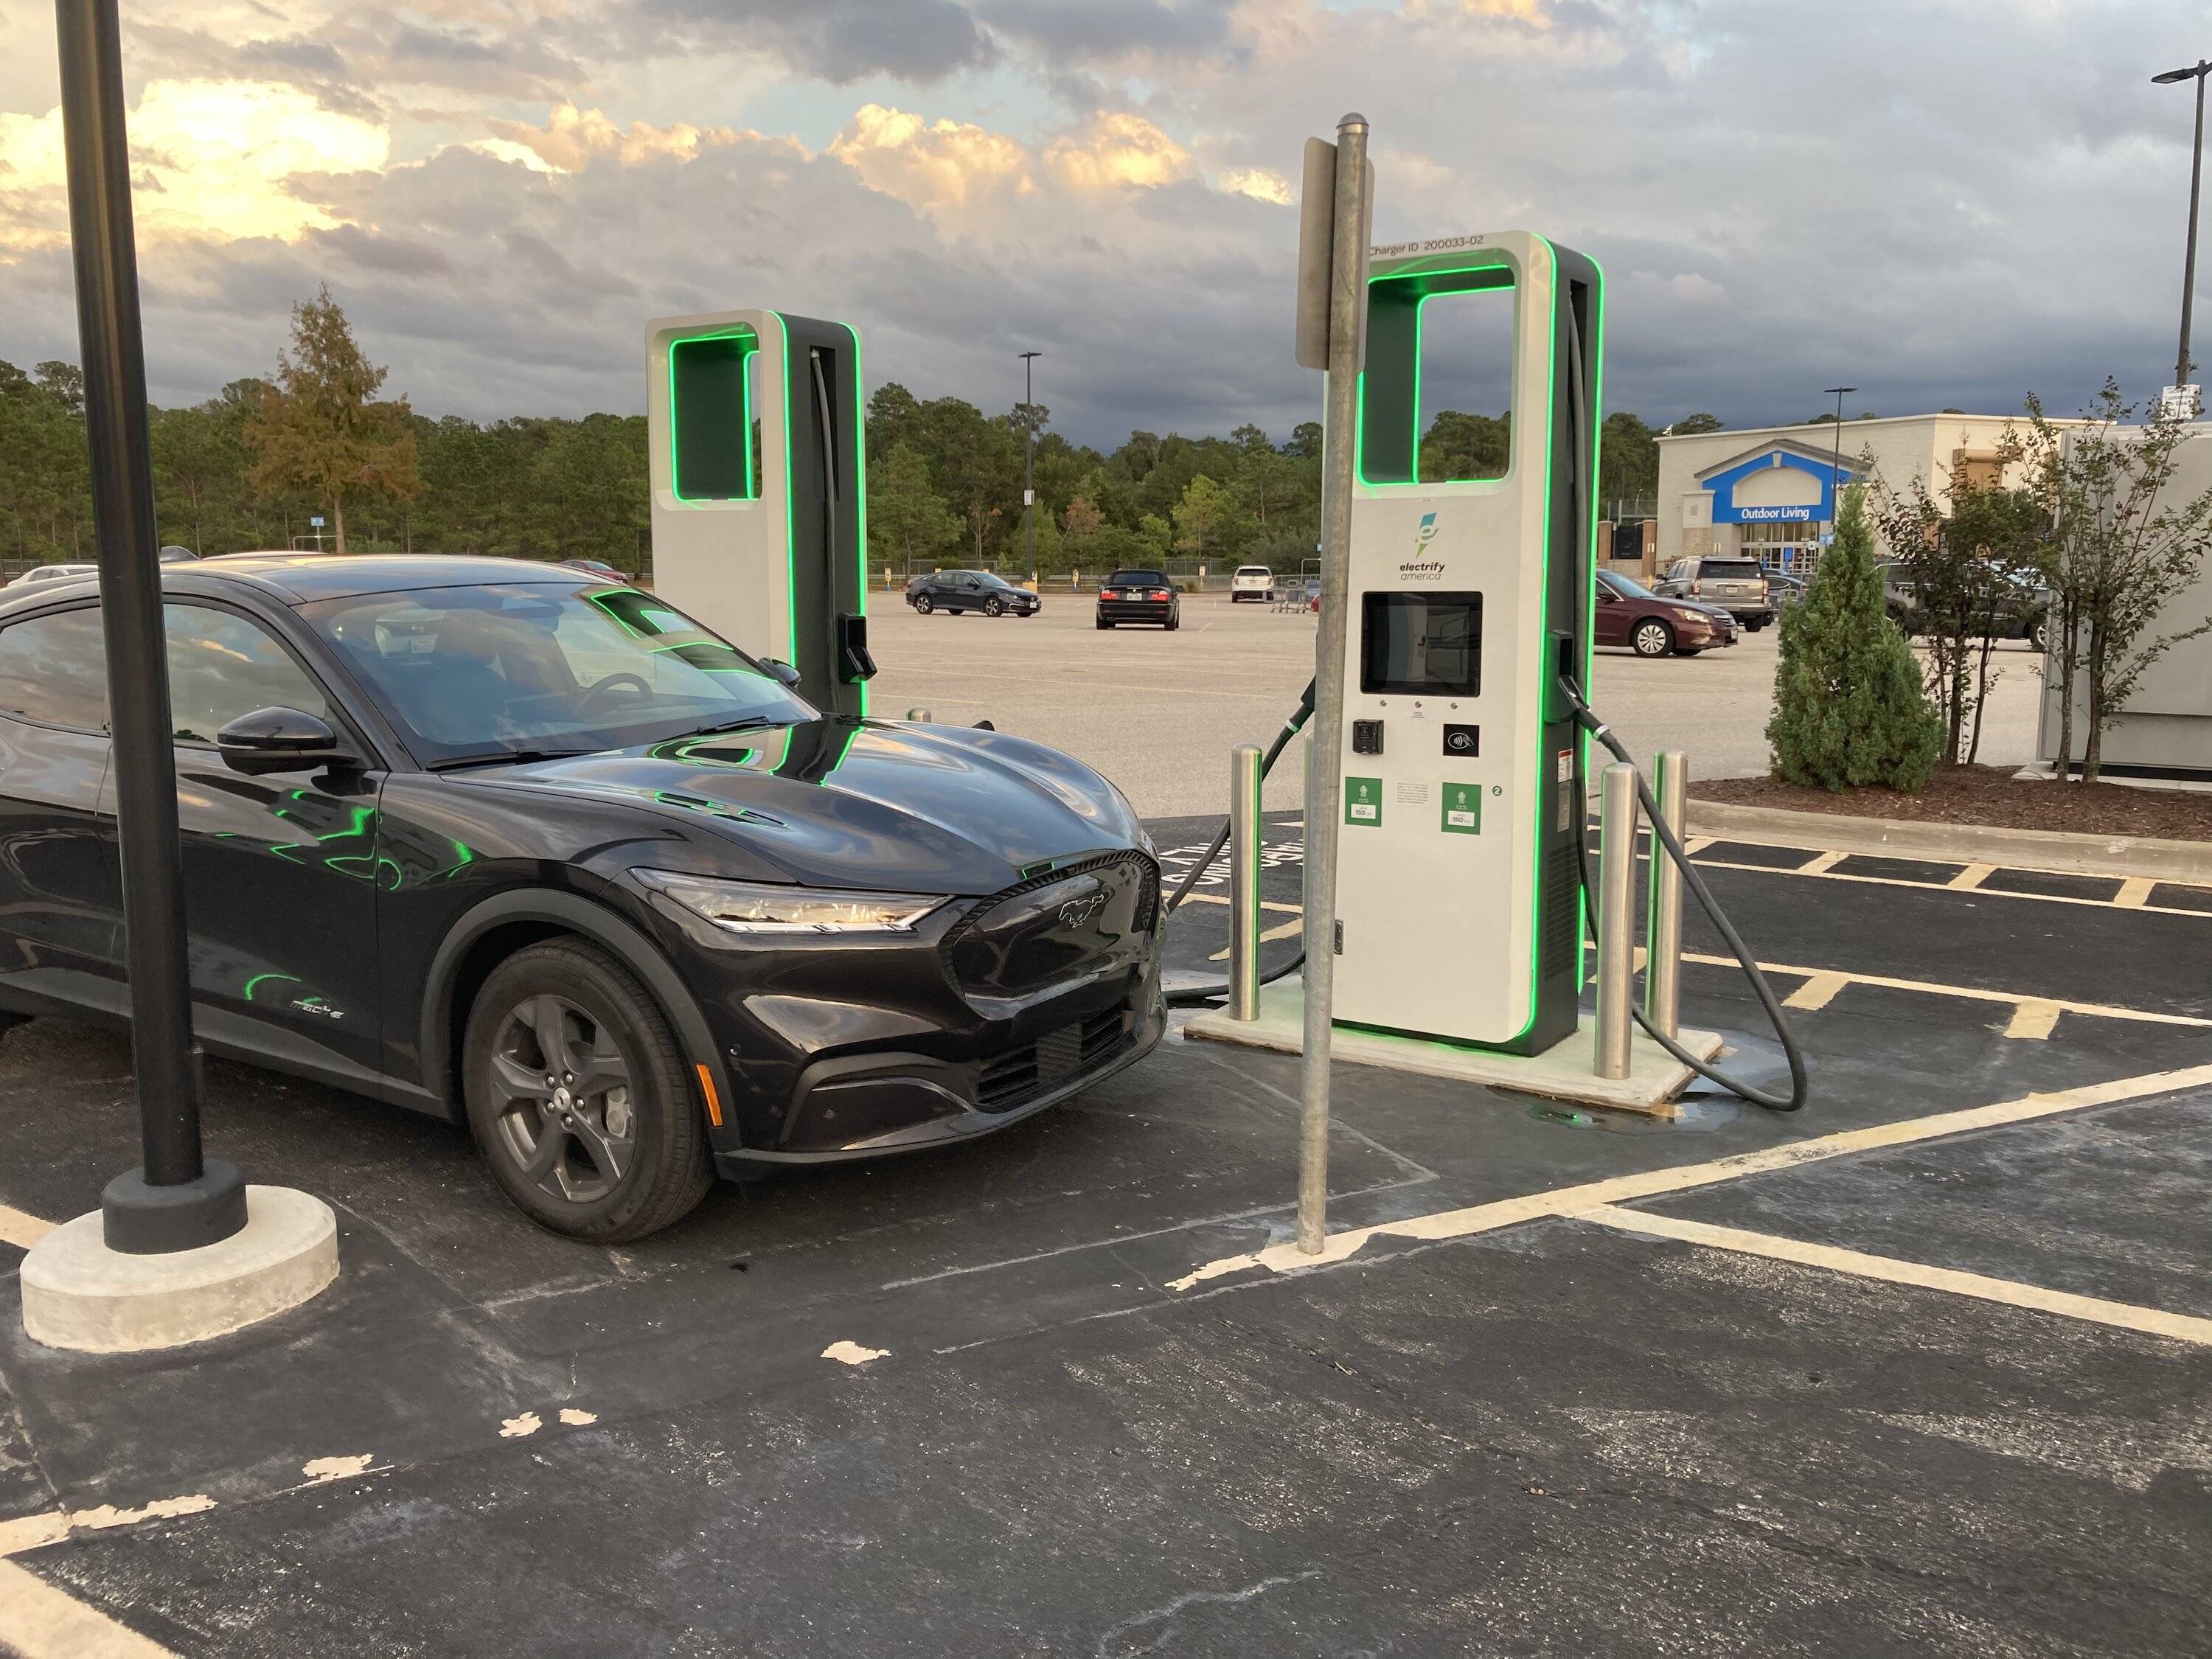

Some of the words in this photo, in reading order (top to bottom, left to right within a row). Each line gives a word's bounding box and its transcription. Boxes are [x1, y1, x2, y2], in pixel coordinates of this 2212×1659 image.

[1370, 244, 1405, 256] Charger
[1408, 243, 1419, 251] ID
[1424, 235, 1484, 251] 200033-02
[1742, 507, 1779, 519] Outdoor
[1781, 507, 1809, 521] Living
[1399, 562, 1445, 573] electrify
[1400, 573, 1441, 581] america
